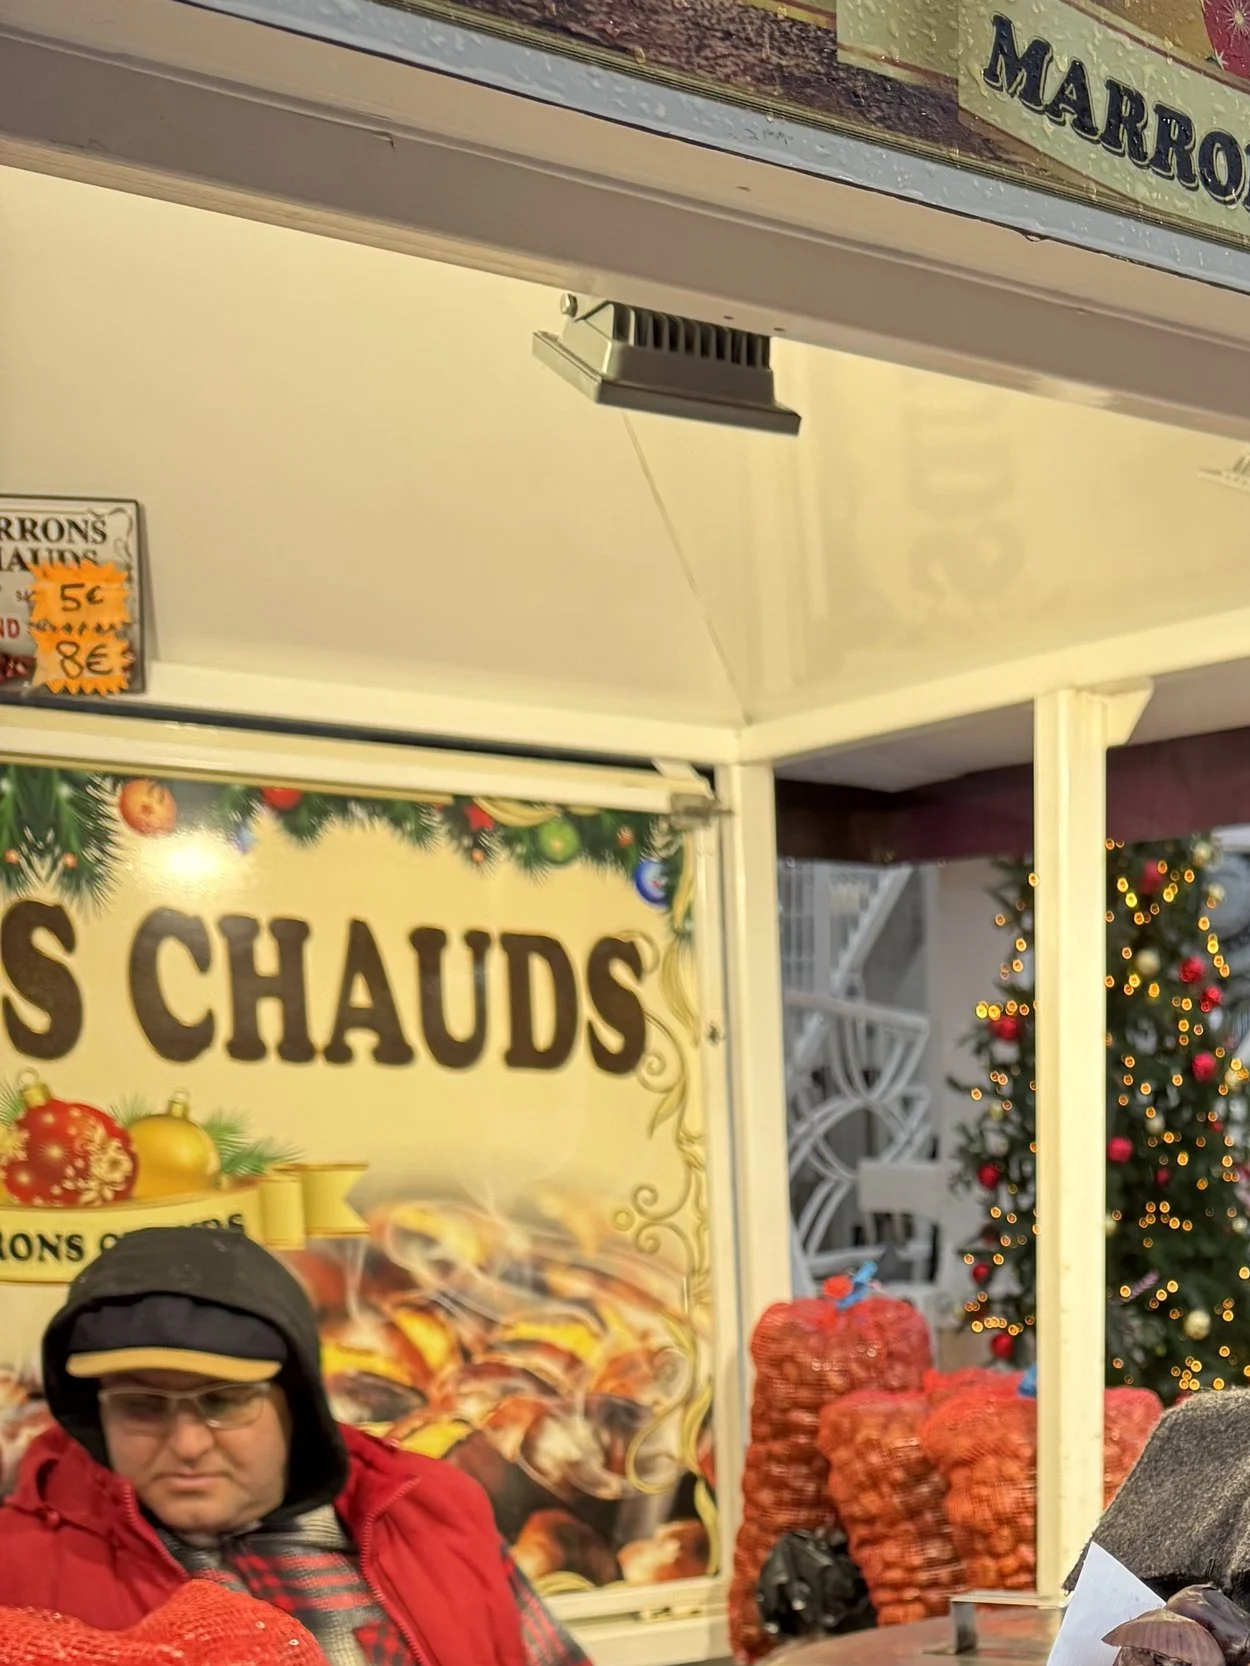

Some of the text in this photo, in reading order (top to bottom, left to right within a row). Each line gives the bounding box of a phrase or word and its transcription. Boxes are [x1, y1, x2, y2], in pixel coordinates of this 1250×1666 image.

[56, 640, 114, 680] 8€
[0, 900, 649, 1076] S CHAUDS
[0, 1232, 85, 1263] ONS
